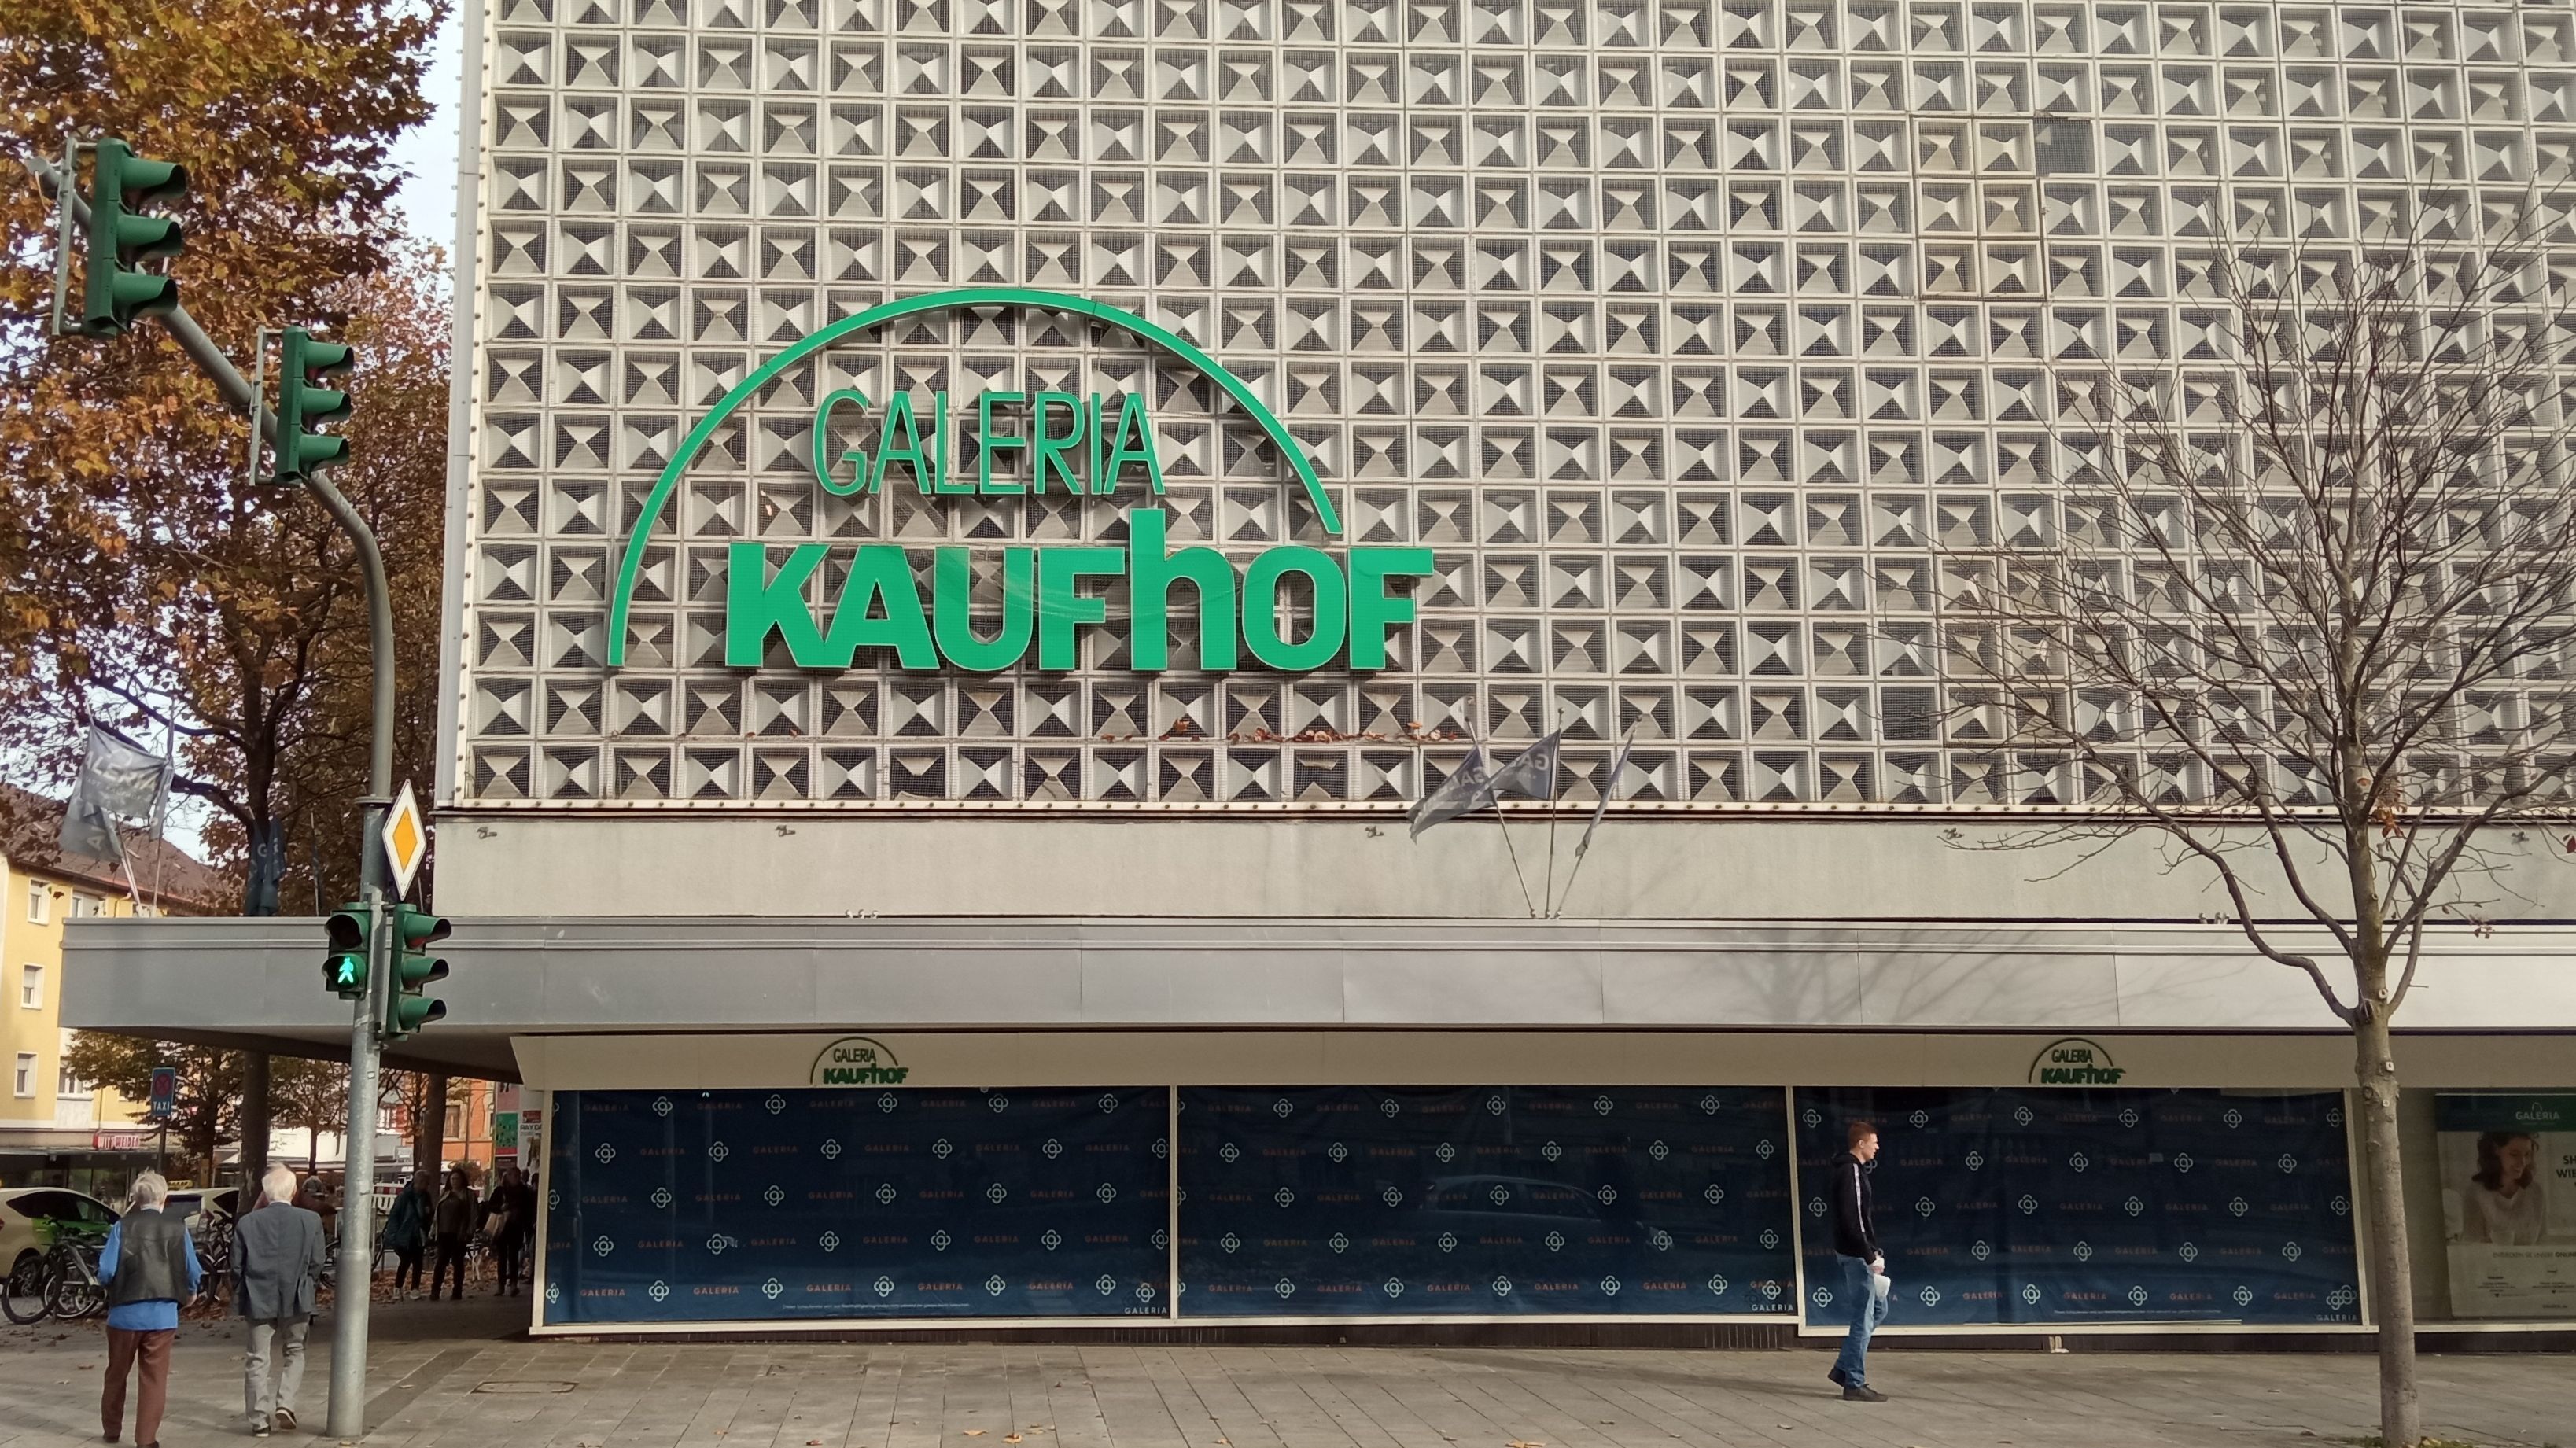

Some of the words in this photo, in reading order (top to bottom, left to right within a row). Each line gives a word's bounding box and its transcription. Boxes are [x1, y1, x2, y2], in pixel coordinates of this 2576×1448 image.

[813, 389, 1166, 497] GALERIA
[833, 1048, 876, 1063] GALERIA
[2051, 1049, 2093, 1063] GALERIA
[153, 1101, 170, 1111] TAXI
[2515, 1111, 2560, 1120] GALERIA
[808, 1191, 853, 1199] GALERIA
[1639, 1191, 1683, 1199] GALERIA
[580, 1288, 625, 1297] GALERIA
[693, 1286, 739, 1295] GALERIA
[806, 1284, 851, 1292] GALERIA
[1963, 1291, 2002, 1299] GALERIA
[2169, 1292, 2213, 1301] GALERIA
